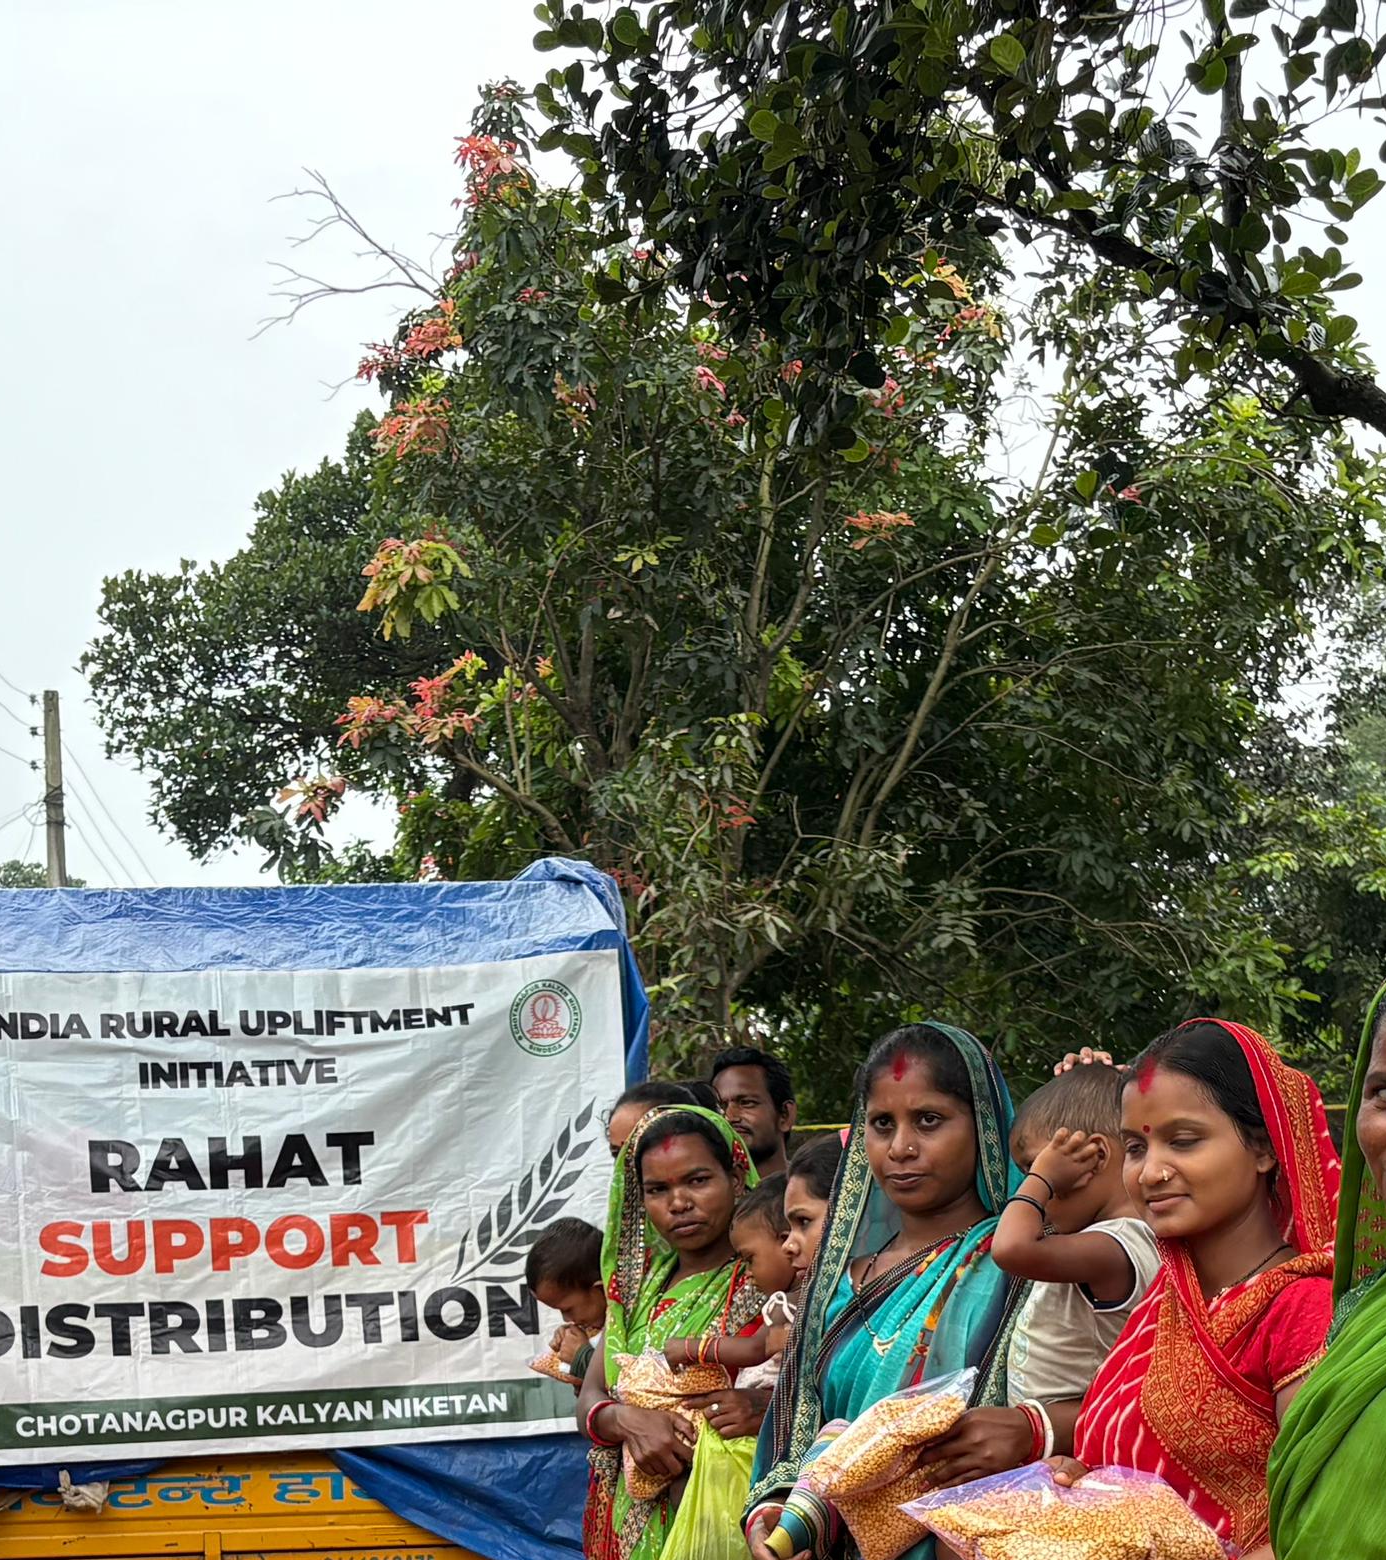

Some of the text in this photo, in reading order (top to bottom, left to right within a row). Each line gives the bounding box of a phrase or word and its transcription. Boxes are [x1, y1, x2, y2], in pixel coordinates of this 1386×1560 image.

[541, 982, 569, 997] KALYAN
[101, 1009, 230, 1038] RURAL
[247, 1003, 476, 1036] UPLIFTMENT
[139, 1058, 339, 1090] INITIATIVE
[88, 1131, 375, 1194] RAHAT
[39, 1210, 429, 1278] SUPPORT
[15, 1392, 508, 1440] CHOTANAGPUR KALYAN NIKETAN
